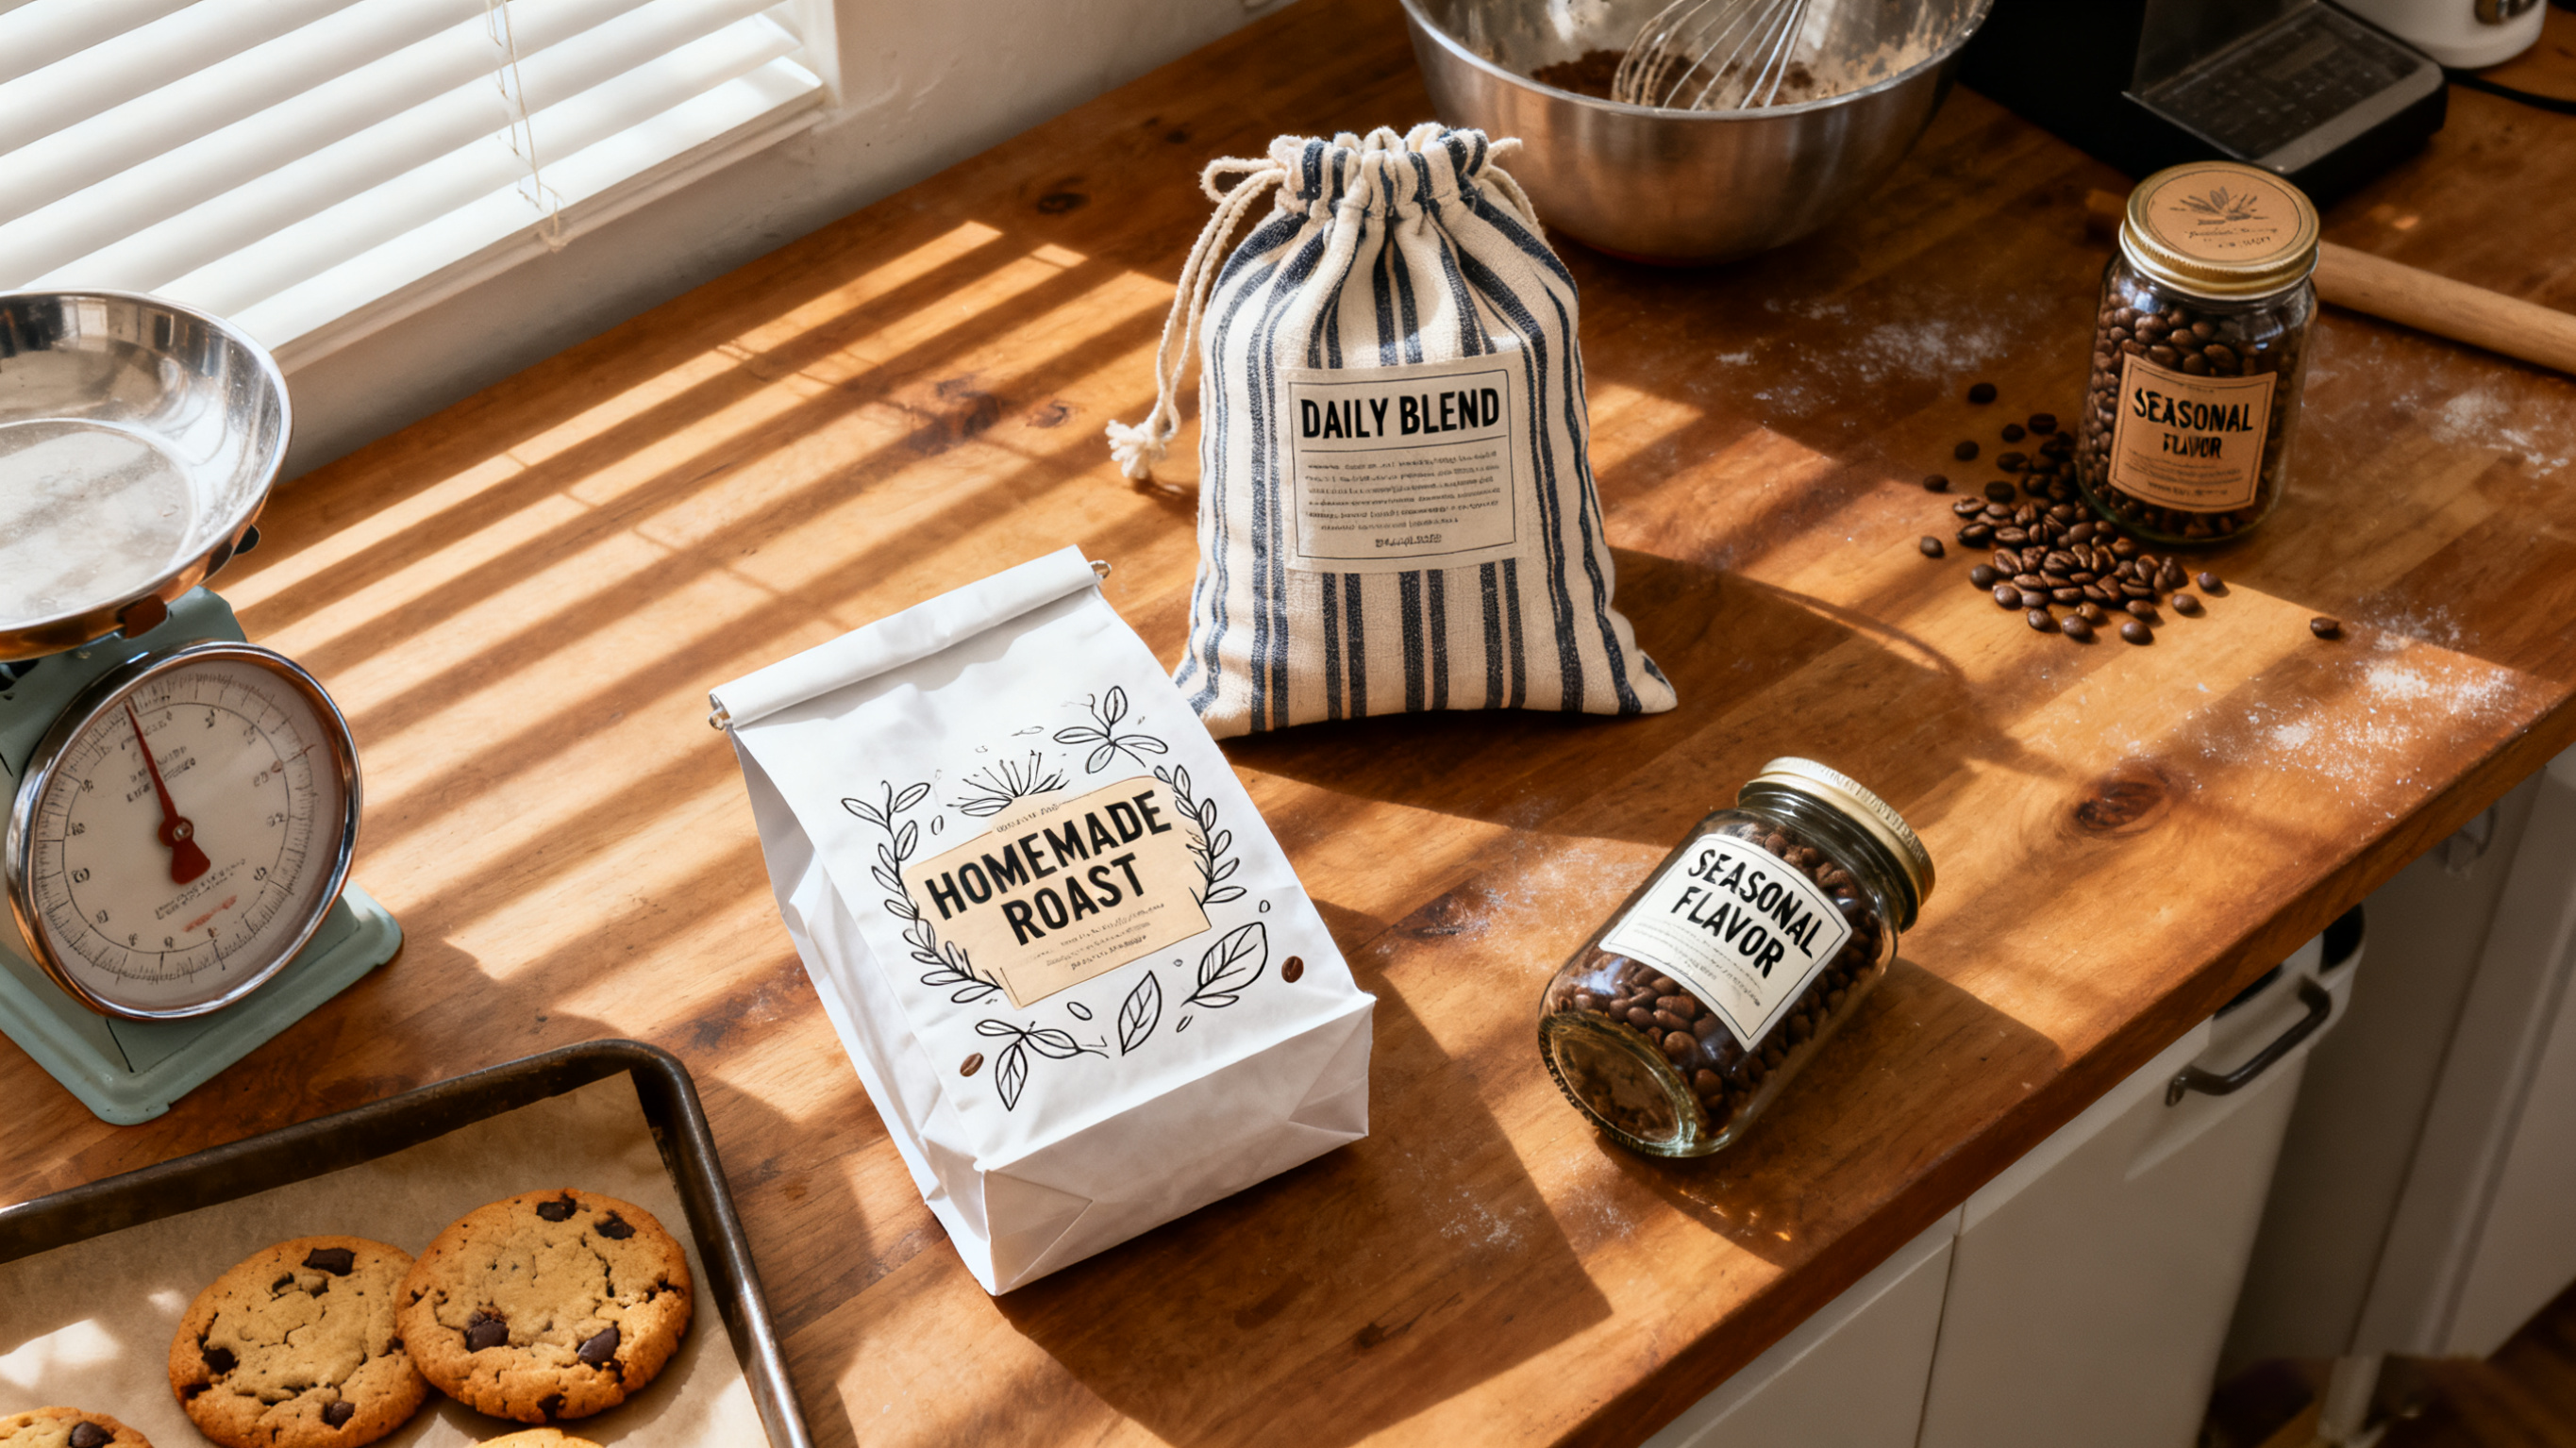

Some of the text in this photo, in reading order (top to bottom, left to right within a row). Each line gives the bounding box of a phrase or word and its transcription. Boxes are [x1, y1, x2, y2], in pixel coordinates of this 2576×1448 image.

[1301, 388, 1499, 439] DAILY BLEND
[2133, 388, 2253, 432] SEASONAL
[925, 790, 1172, 921] HOMEMADE
[1001, 851, 1146, 946] ROAST
[1670, 886, 1785, 979] FLAVOR
[1687, 849, 1823, 959] SEASONAL
